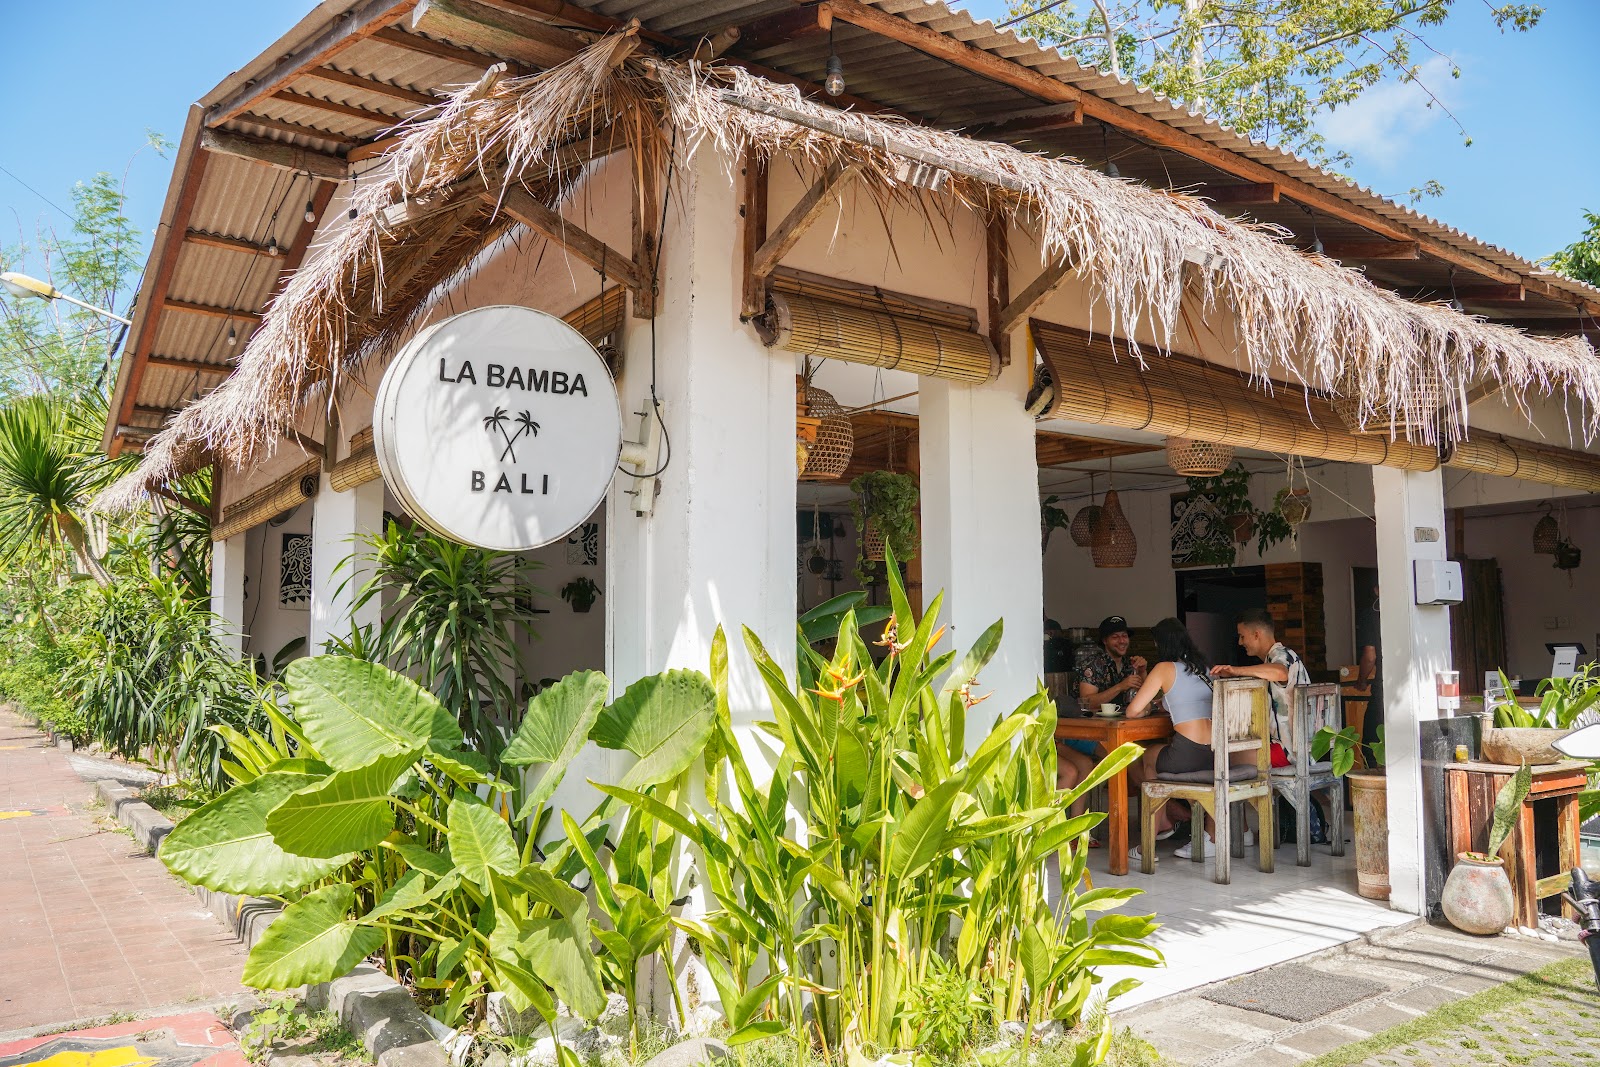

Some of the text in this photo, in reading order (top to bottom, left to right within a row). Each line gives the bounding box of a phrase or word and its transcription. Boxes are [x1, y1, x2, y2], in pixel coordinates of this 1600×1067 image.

[439, 357, 588, 398] LA BAMBA
[471, 470, 549, 495] BALI
